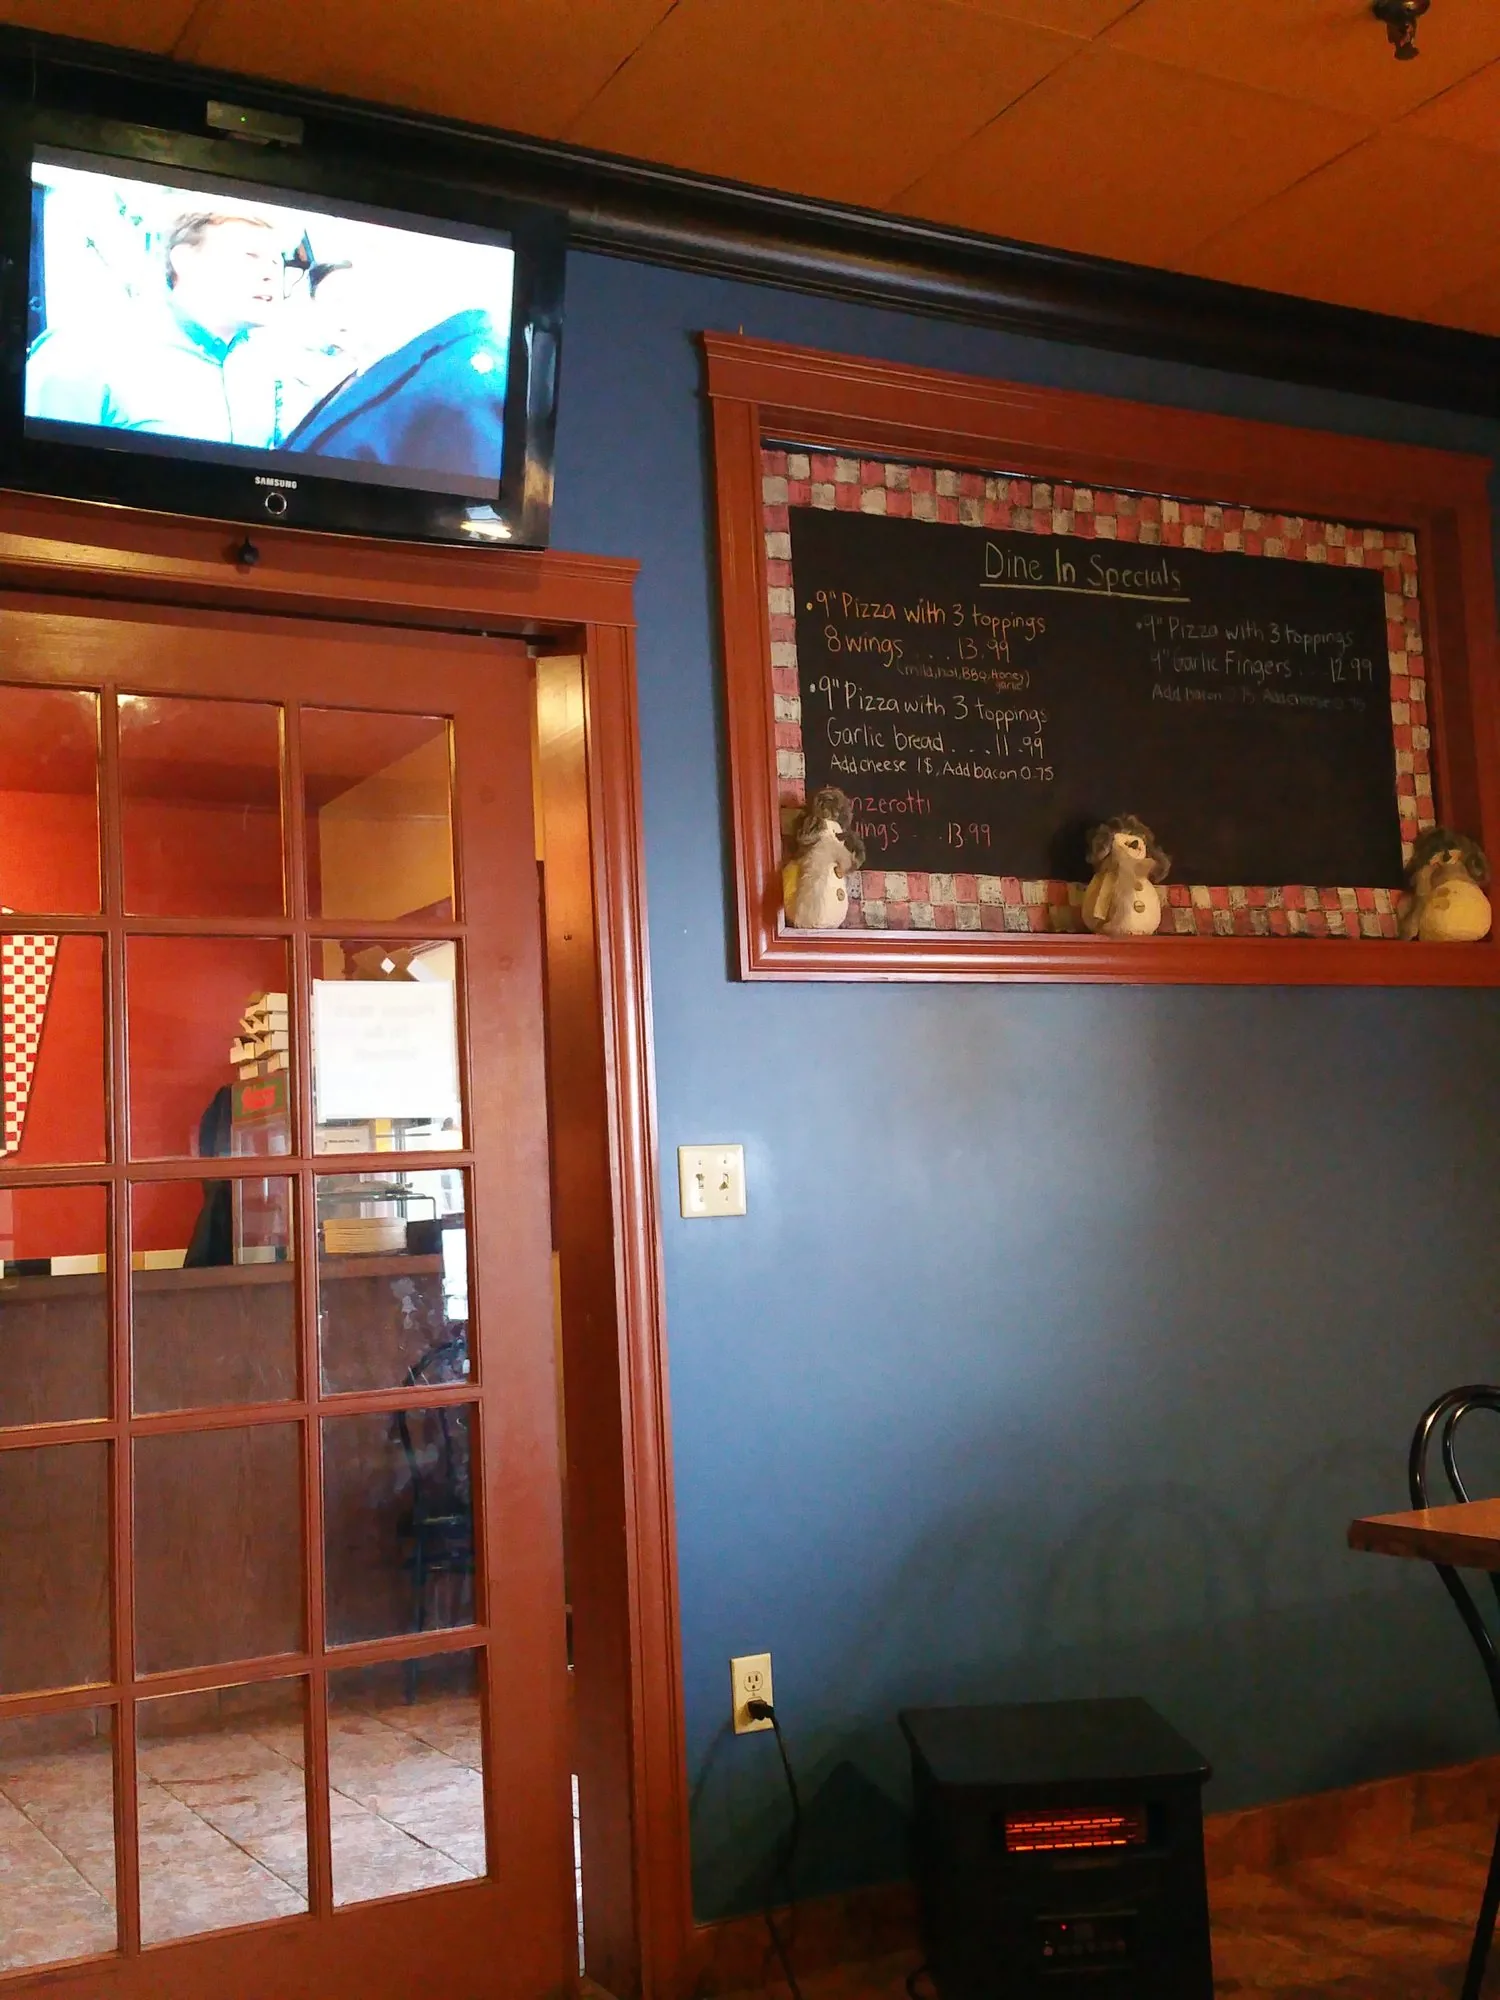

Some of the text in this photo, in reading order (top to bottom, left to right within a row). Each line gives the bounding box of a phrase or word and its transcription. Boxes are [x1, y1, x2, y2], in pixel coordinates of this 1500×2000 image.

[254, 475, 298, 490] SAMSUNG
[984, 541, 1182, 596] Dine In Specials
[842, 592, 896, 620] Pizza
[904, 598, 946, 626] with
[952, 603, 965, 627] 3
[971, 603, 1046, 641] toppings
[1168, 617, 1218, 640] Pizza
[1225, 621, 1265, 643] with
[1270, 622, 1281, 644] 3
[1285, 624, 1355, 654] toppings
[823, 624, 905, 667] 8 wings
[1224, 650, 1292, 685] Fingers
[843, 680, 900, 713] Pizza
[903, 695, 947, 717] with
[952, 695, 969, 720] 3
[975, 697, 1049, 734] toppings
[826, 716, 944, 754] Garlic bread
[830, 757, 857, 775] Add
[857, 756, 907, 774] cheese
[942, 759, 972, 778] Add
[972, 762, 1018, 781] bacon
